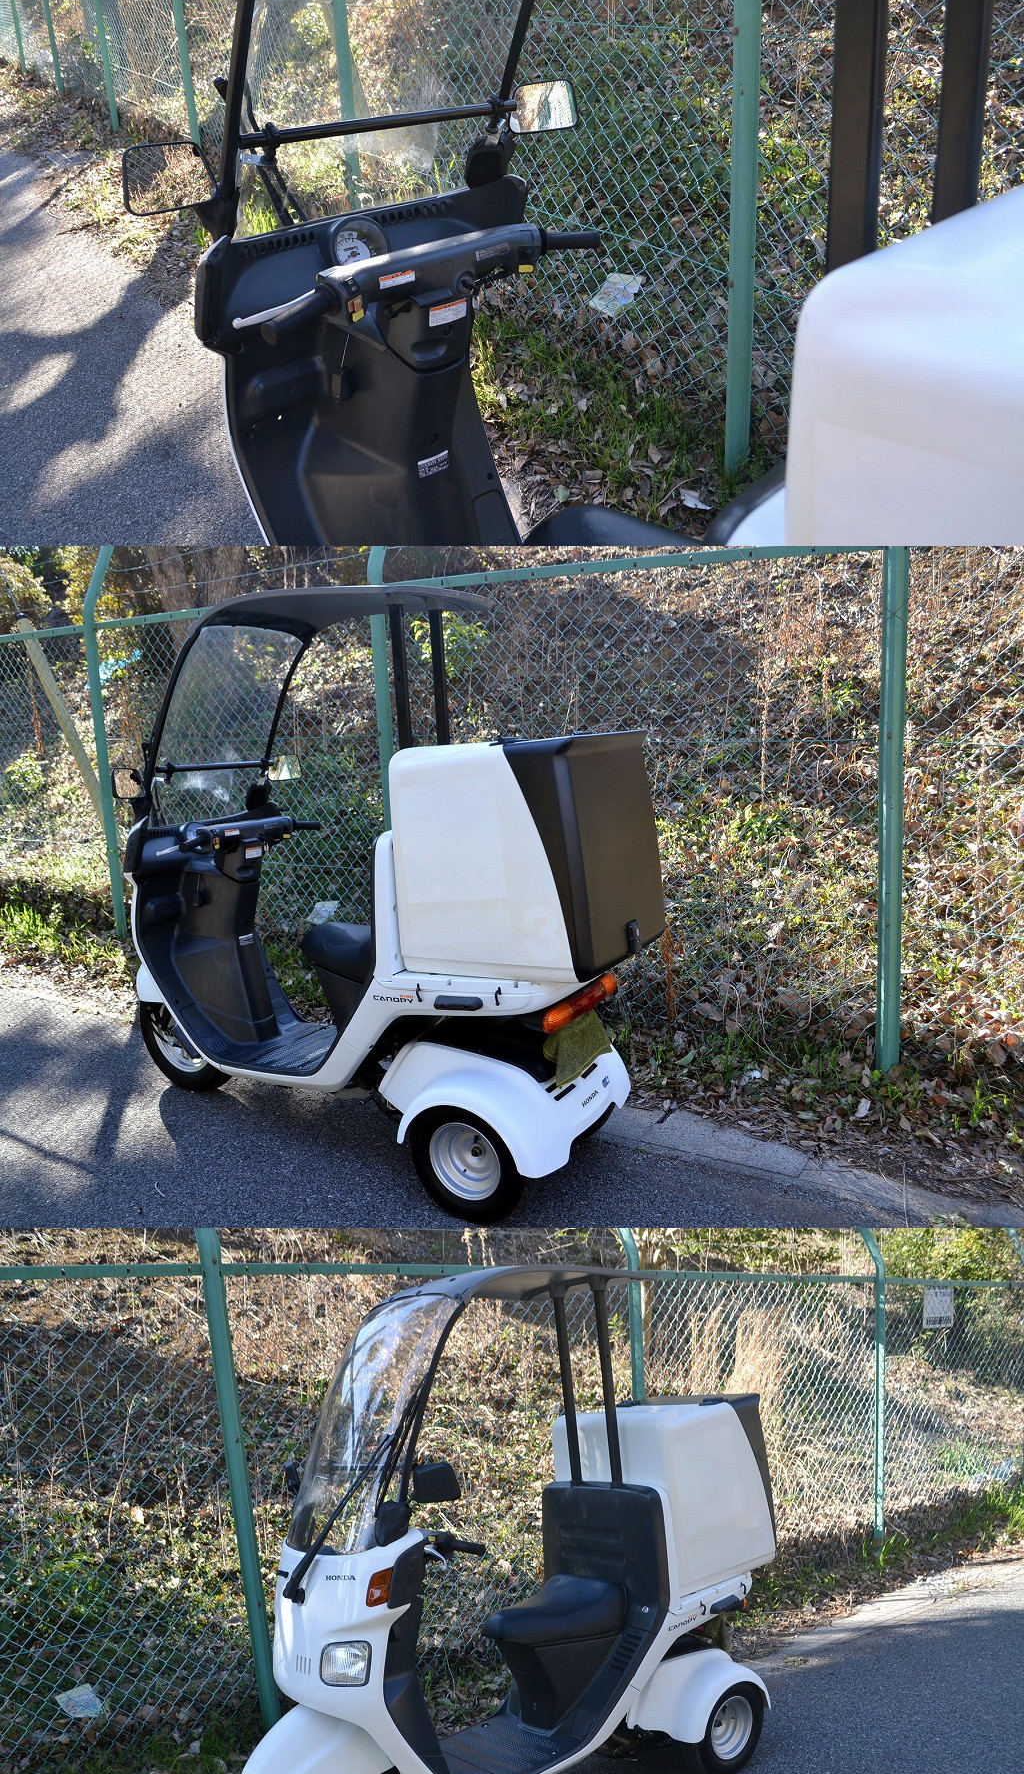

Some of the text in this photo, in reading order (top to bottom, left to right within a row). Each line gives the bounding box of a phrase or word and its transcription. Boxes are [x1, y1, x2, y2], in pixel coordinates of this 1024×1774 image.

[373, 995, 414, 1004] CANOPY
[581, 1090, 599, 1108] HONDA
[668, 1615, 697, 1632] CANOPY
